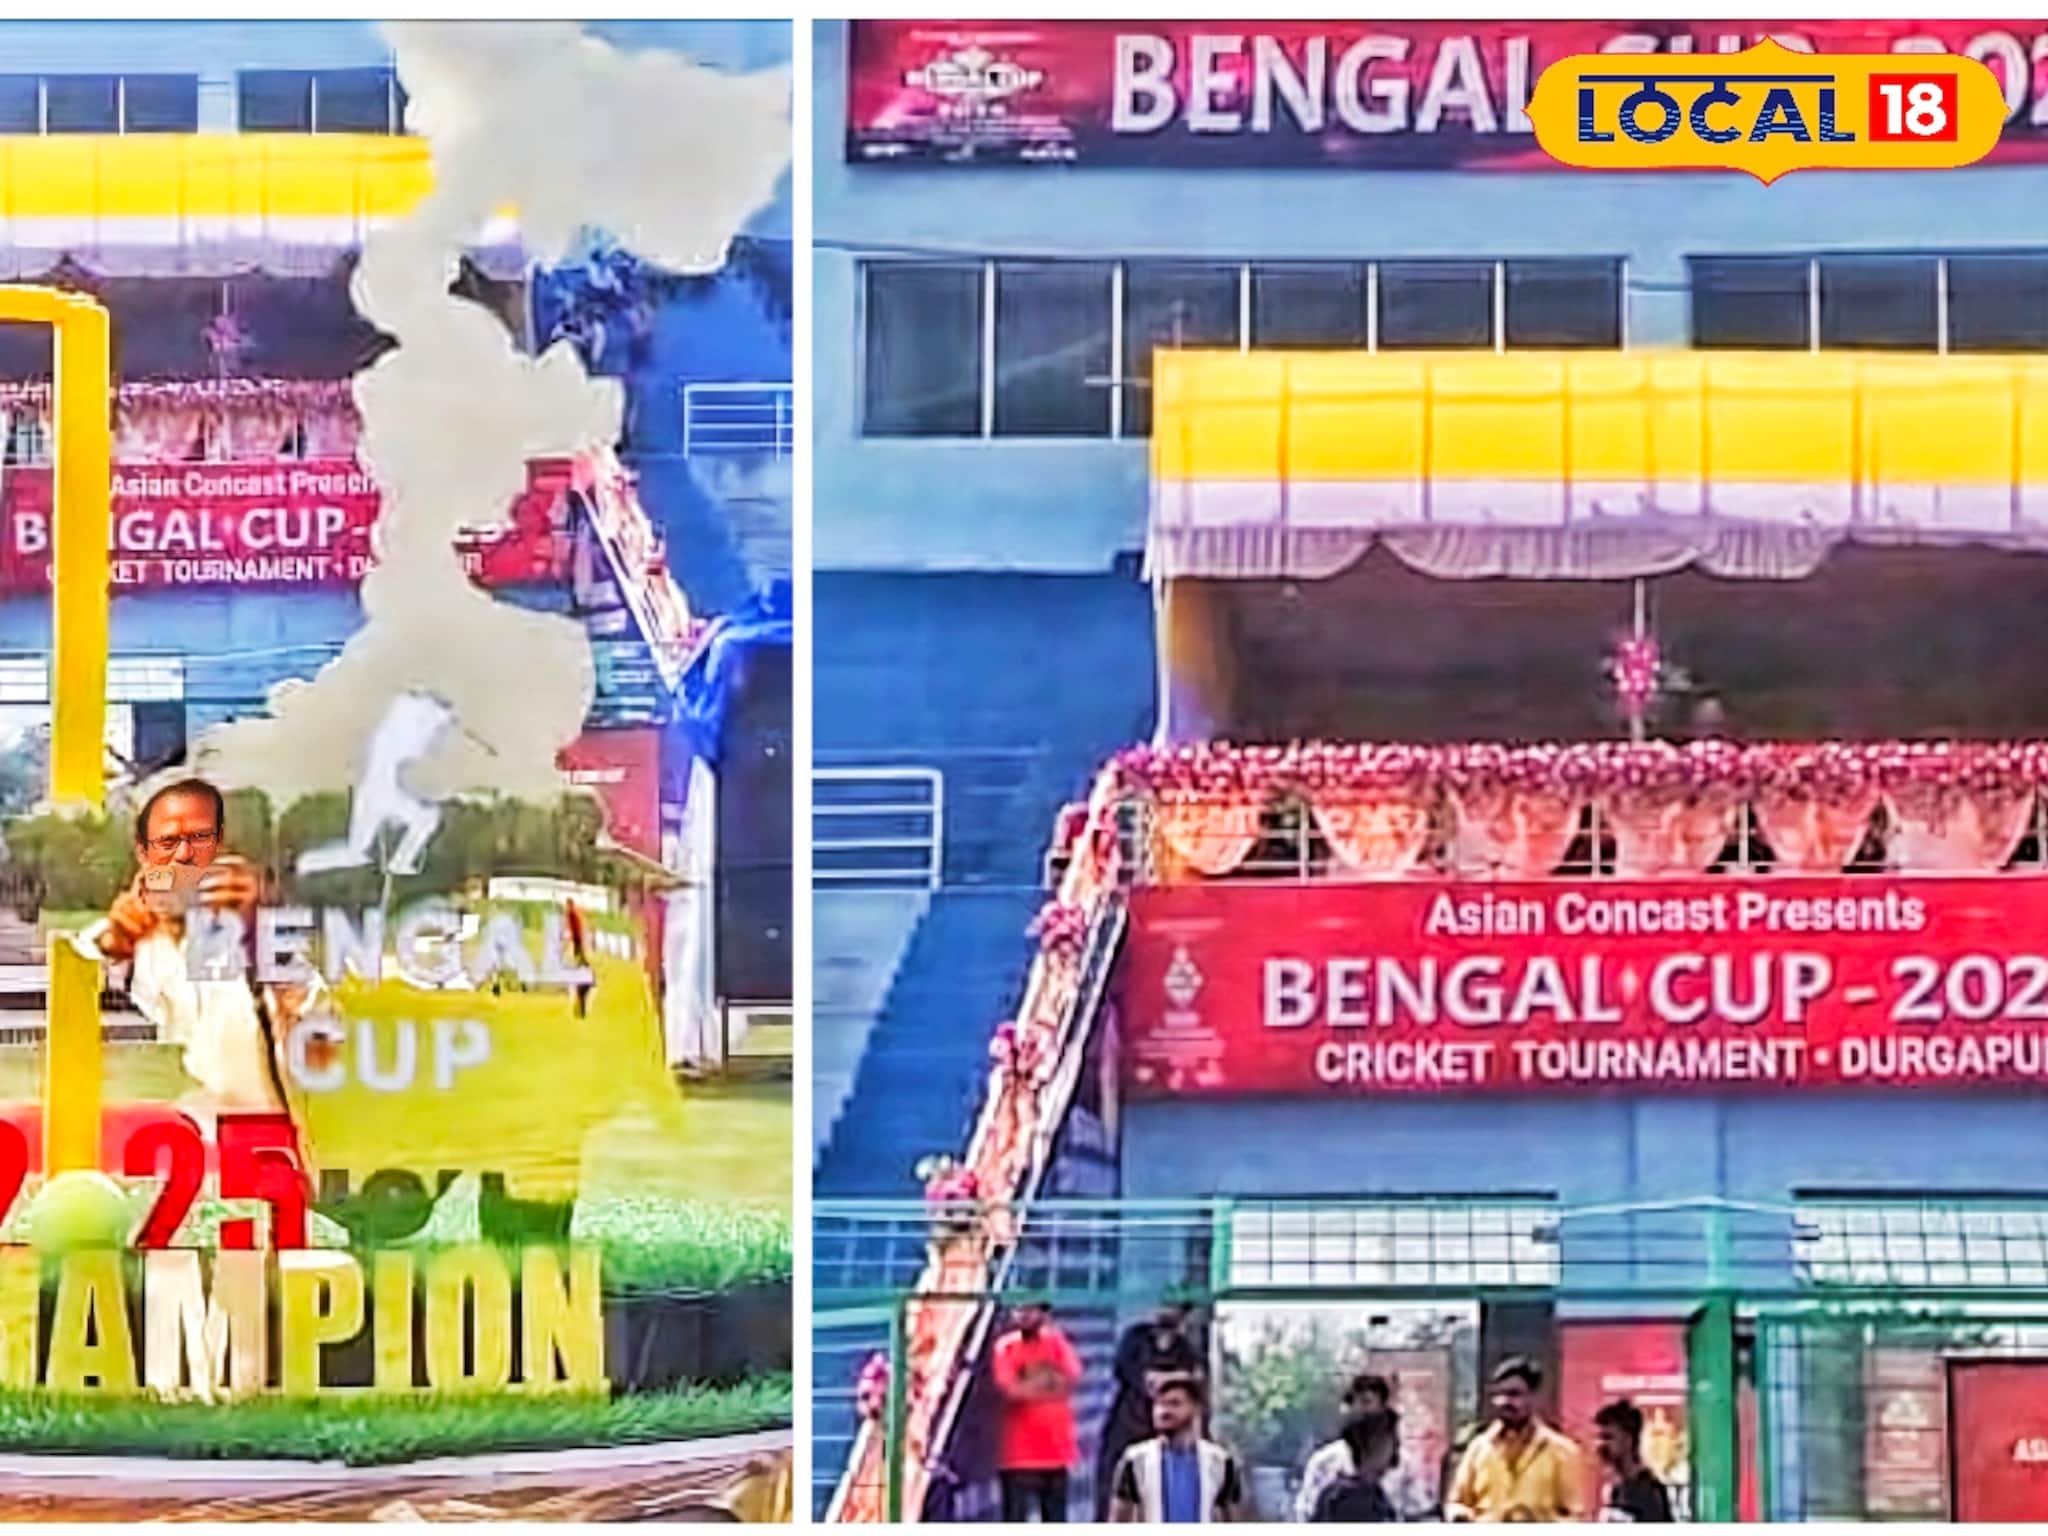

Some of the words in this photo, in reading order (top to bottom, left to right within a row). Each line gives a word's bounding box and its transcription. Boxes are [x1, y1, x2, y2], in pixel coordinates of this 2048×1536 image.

[1111, 33, 1534, 134] BENGAL
[111, 472, 180, 497] Asian
[14, 508, 225, 552] BGAL
[239, 506, 346, 549] CUP
[163, 556, 336, 583] TOURNAMENT
[1426, 892, 1545, 935] Asian
[1555, 892, 1728, 935] Concast
[1737, 889, 1926, 932] Presents
[184, 900, 595, 988] BENGAL
[1262, 954, 1623, 1028] BENGAL
[1648, 951, 1832, 1024] CUP
[289, 1014, 494, 1092] CUP
[1314, 1040, 1496, 1083] CRICKET
[1510, 1035, 1808, 1083] TOURNAMENT
